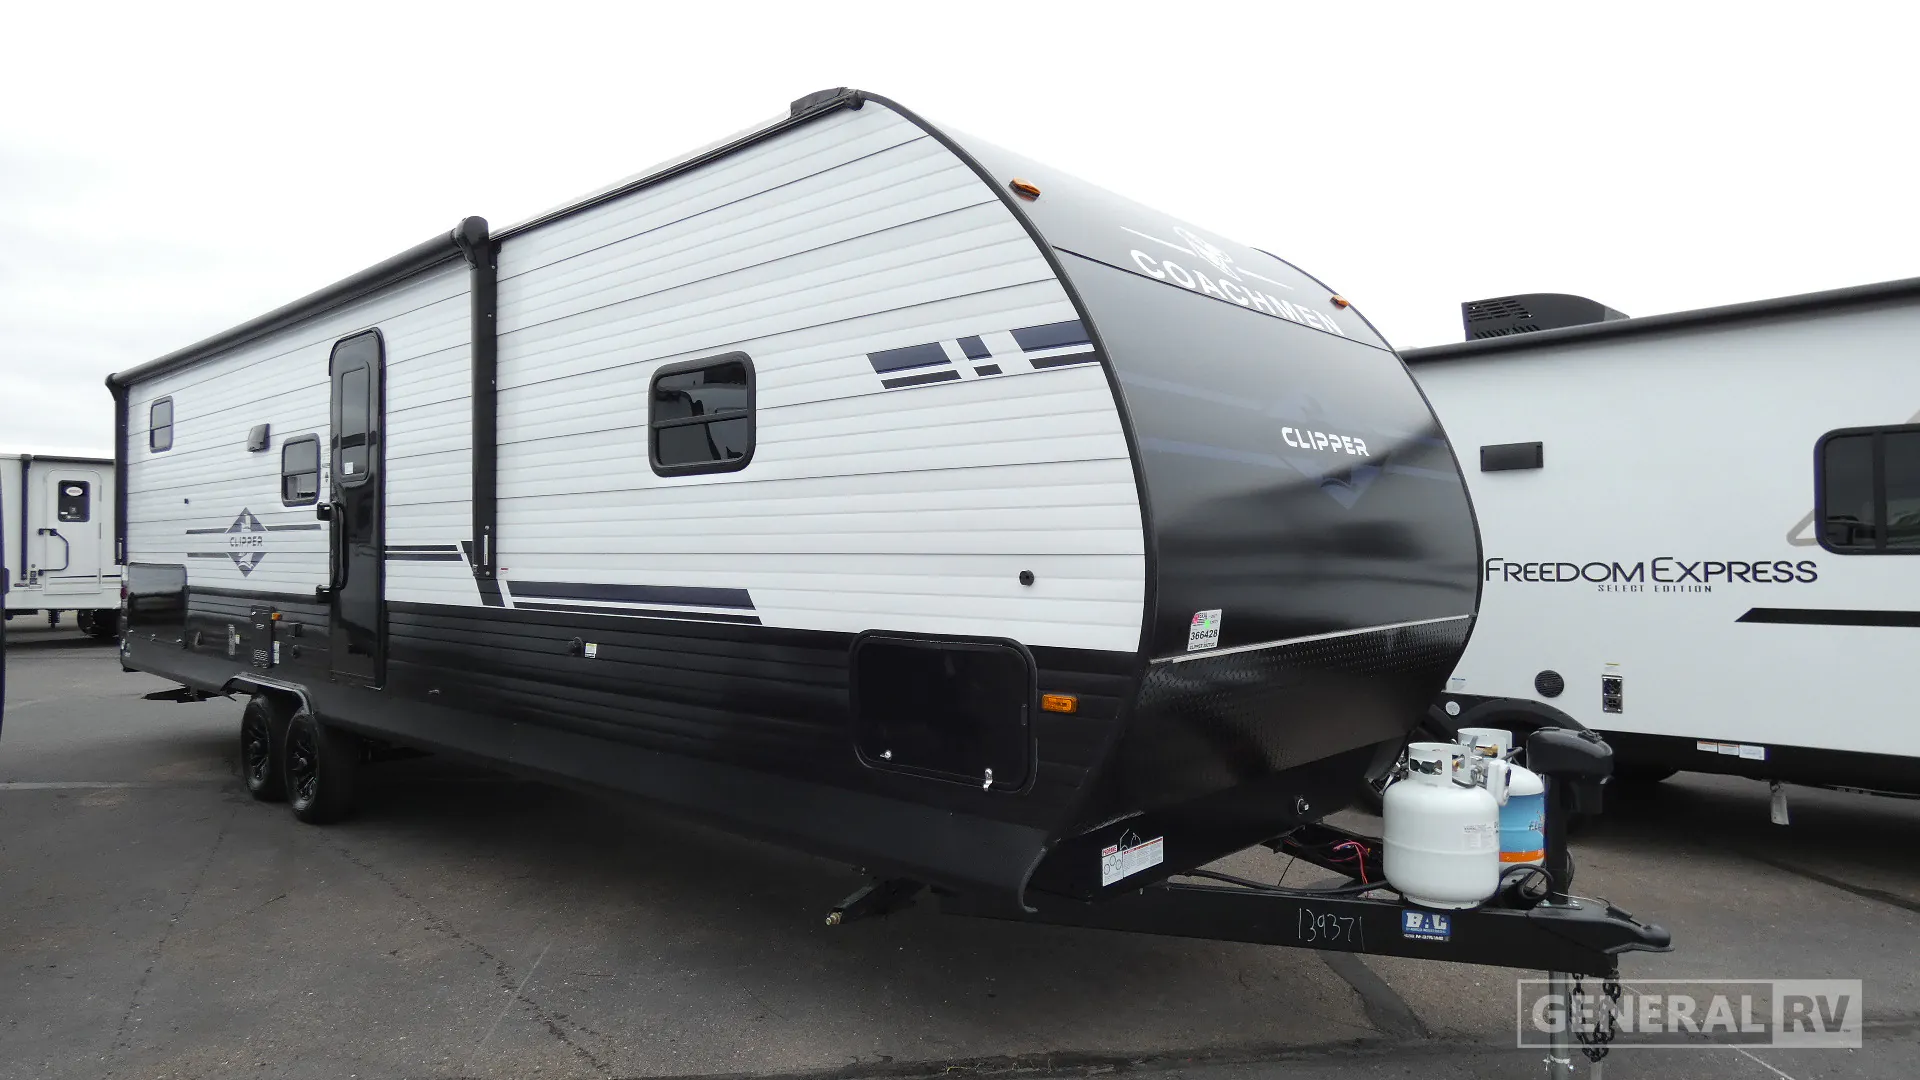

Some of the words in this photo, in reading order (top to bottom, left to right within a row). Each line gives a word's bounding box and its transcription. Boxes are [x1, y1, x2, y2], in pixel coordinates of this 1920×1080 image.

[1130, 249, 1344, 336] COACHMEN
[1281, 426, 1370, 457] CLIPPER
[229, 535, 264, 547] CLIPPER
[1485, 557, 1645, 583] FREEDOM
[1650, 556, 1819, 583] EXPRESS
[1597, 584, 1645, 593] SELECT
[1654, 585, 1713, 593] EDITION
[1298, 907, 1366, 952] 139371
